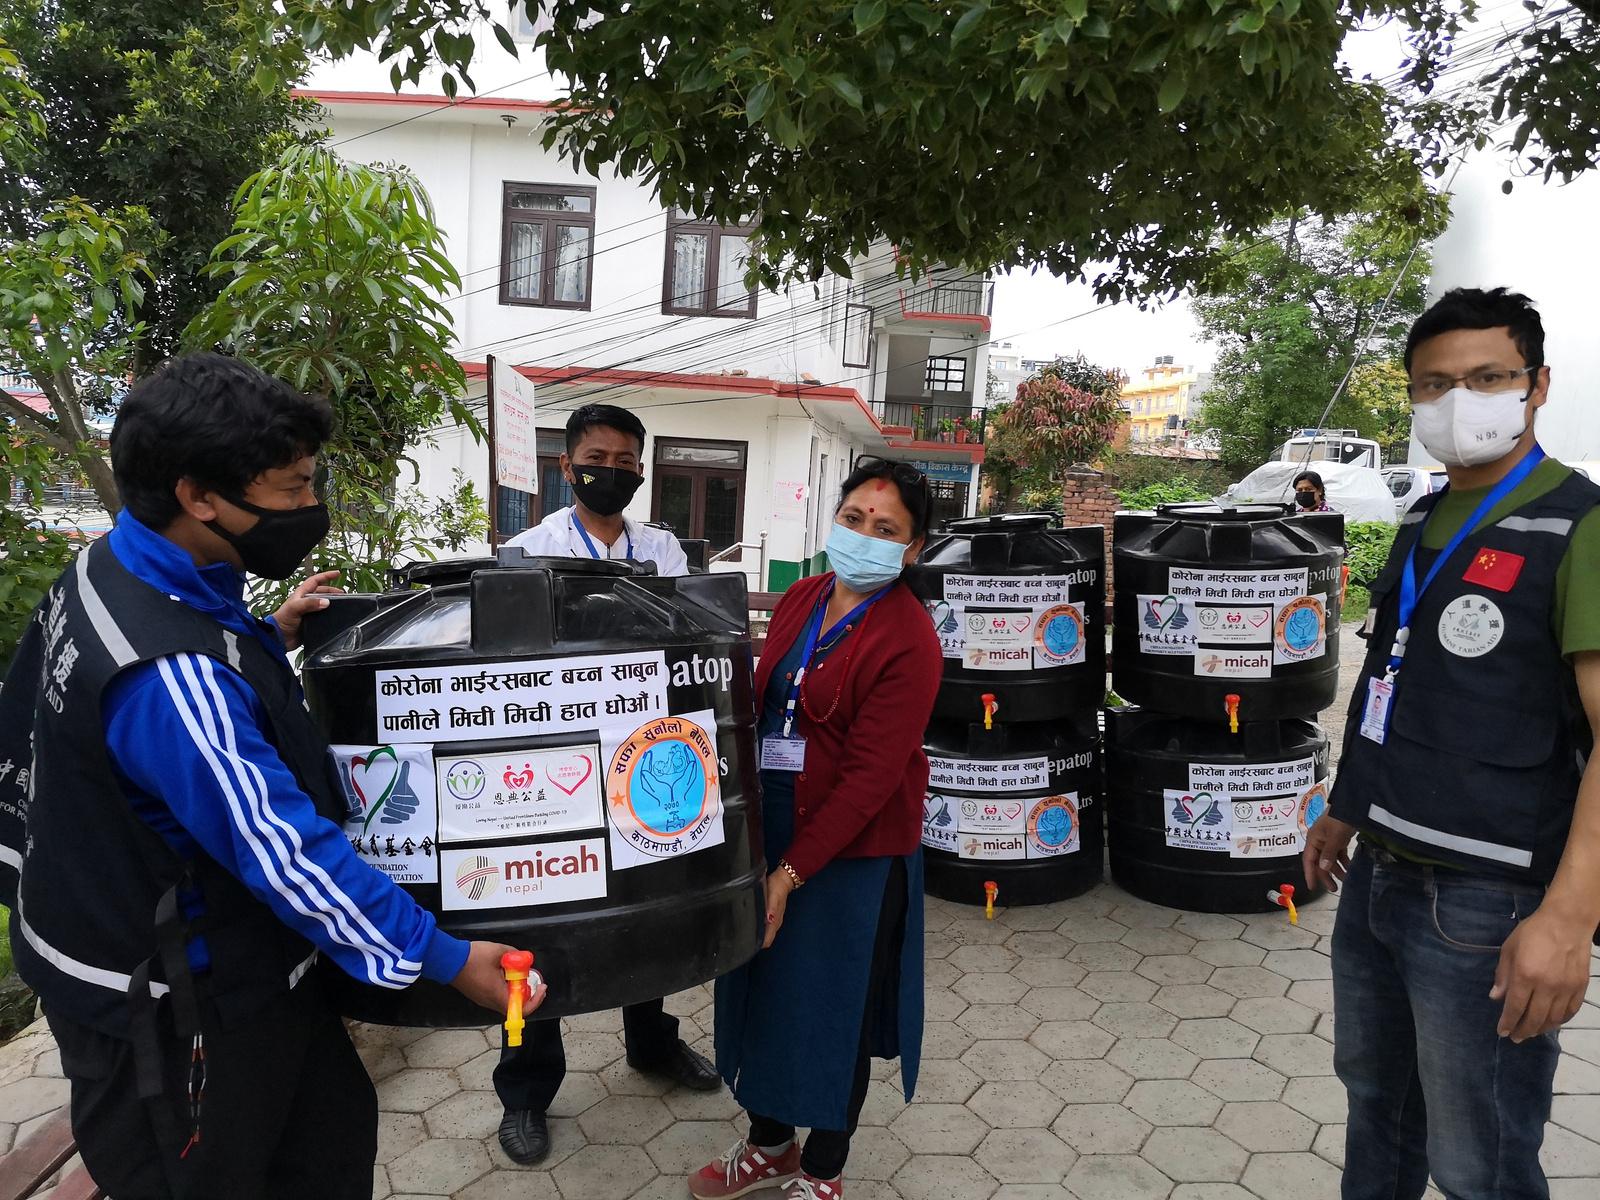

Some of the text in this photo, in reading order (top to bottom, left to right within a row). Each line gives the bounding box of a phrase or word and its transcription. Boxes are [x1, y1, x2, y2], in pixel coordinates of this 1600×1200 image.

[1475, 430, 1498, 442] N 95
[928, 461, 950, 472] विकास
[1171, 570, 1204, 583] कोरोना
[1258, 589, 1276, 598] हात
[989, 647, 1029, 660] micah
[1225, 654, 1269, 668] micah
[381, 661, 659, 697] कोरोना भाईरसबाट बच्न साबुन
[667, 652, 734, 692] atop
[45, 685, 64, 713] AID
[382, 708, 441, 732] पानीले
[449, 705, 496, 729] मिची
[503, 701, 552, 725] मिची
[560, 701, 598, 722] हात
[689, 727, 711, 759] नेपाल
[1048, 750, 1093, 776] epatop
[1191, 766, 1225, 777] कोरोना
[1193, 782, 1223, 793] पानीले
[689, 814, 711, 841] नेपाल
[983, 838, 1023, 851] micah
[1258, 833, 1296, 847] micah
[504, 844, 599, 881] micah
[505, 880, 544, 895] nepal
